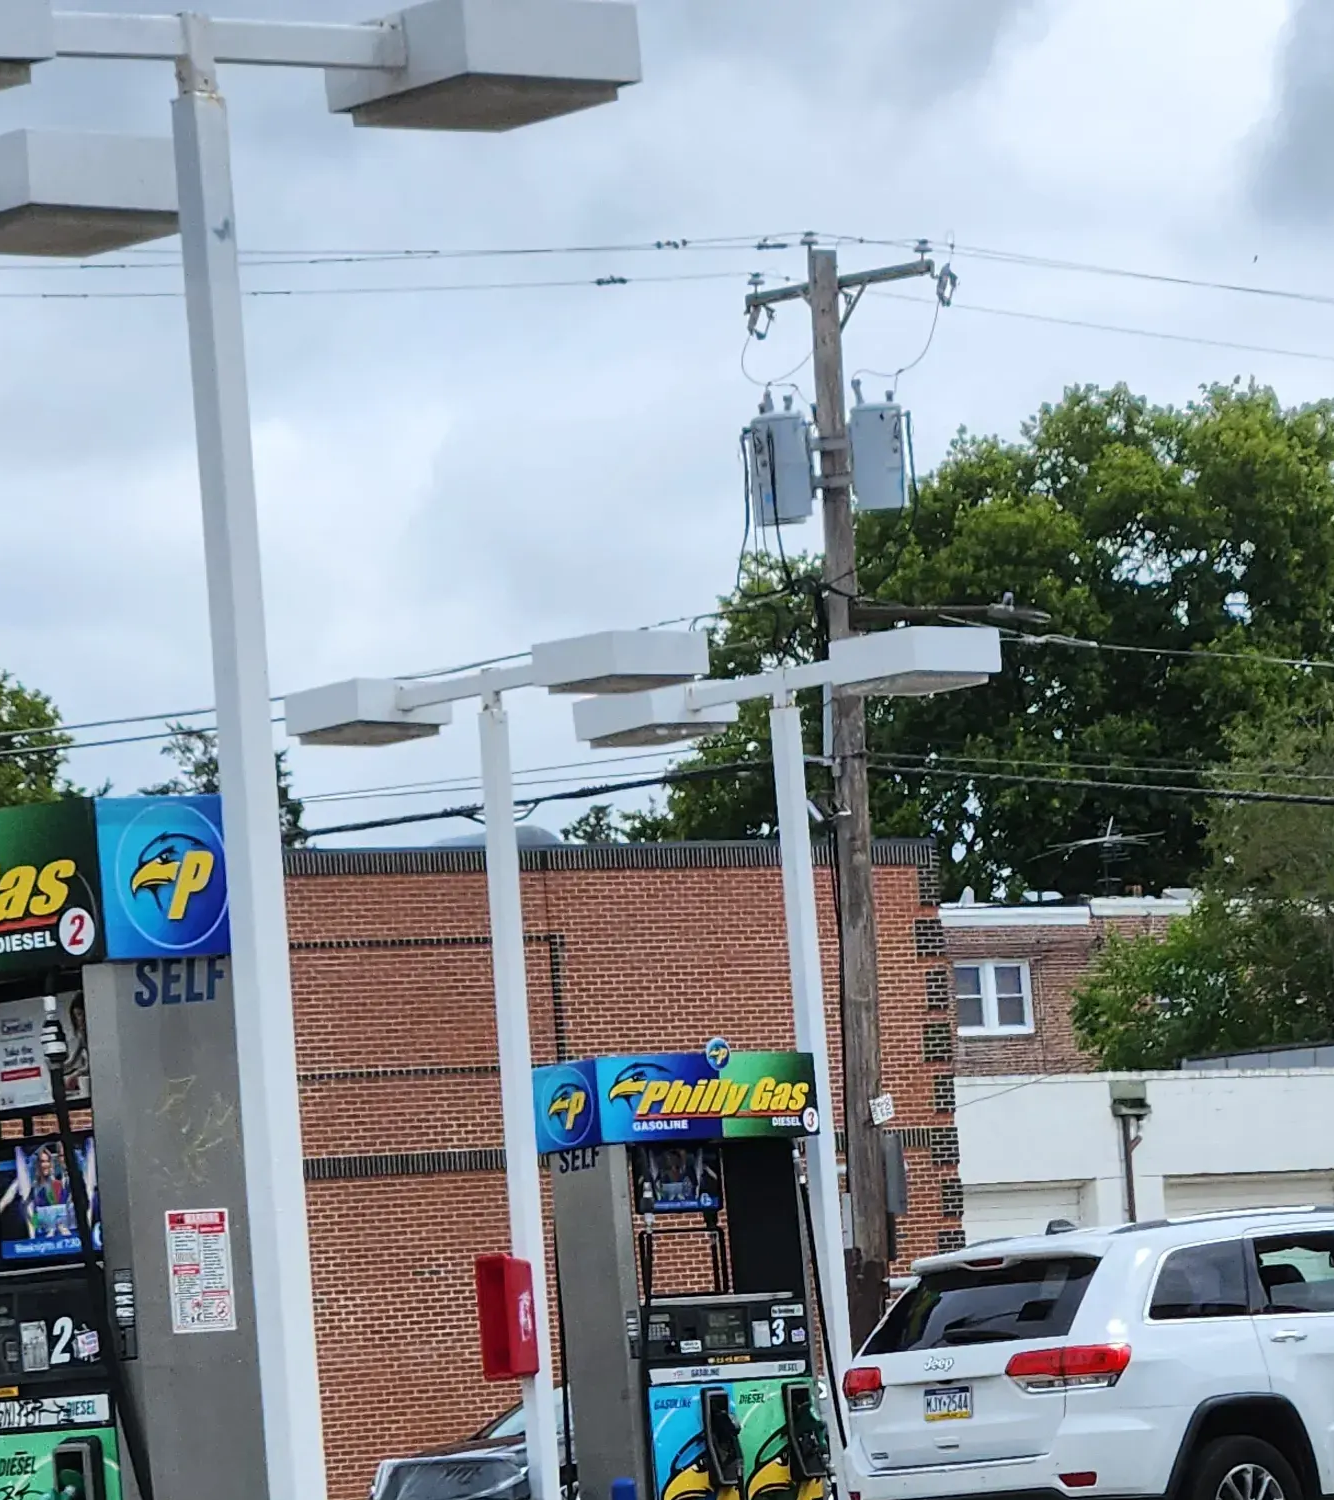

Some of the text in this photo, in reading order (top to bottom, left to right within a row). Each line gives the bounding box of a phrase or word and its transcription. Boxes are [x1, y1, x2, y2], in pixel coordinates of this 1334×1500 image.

[67, 913, 86, 947] 2
[134, 958, 225, 1008] SELF
[636, 1076, 810, 1116] Philly Gas
[633, 1110, 816, 1132] GASOLINE DIESEL 3
[558, 1148, 600, 1174] SELF
[50, 1316, 74, 1365] 2
[771, 1318, 786, 1346] 3
[690, 1368, 720, 1378] GASOLINE
[777, 1363, 798, 1373] DIESEL
[923, 1356, 955, 1372] Jeep
[654, 1398, 692, 1410] GASOLINE
[739, 1392, 766, 1405] DIESEL
